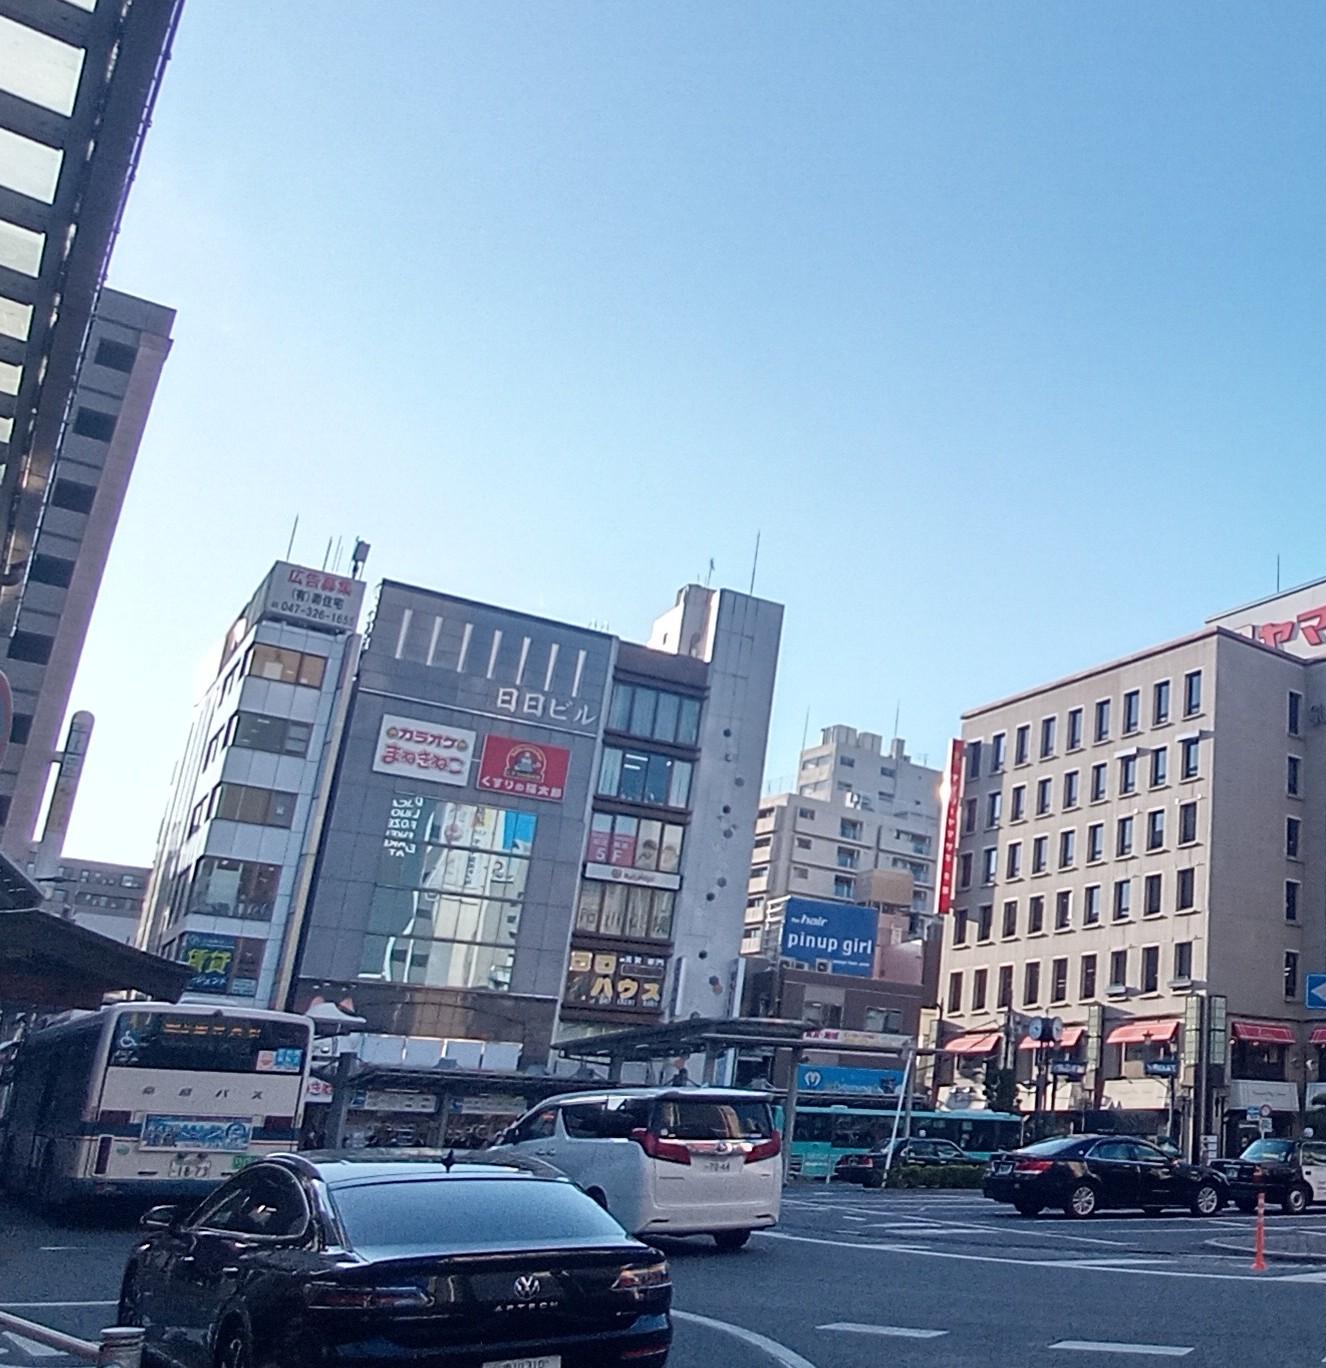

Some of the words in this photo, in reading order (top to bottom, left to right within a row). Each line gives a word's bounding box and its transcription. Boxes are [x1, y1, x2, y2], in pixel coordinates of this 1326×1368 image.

[497, 688, 597, 726] 日日ビル
[398, 728, 458, 750] カラオケ
[382, 745, 463, 774] まねきねこ
[481, 776, 564, 799] くすりの福太郎
[788, 932, 838, 952] pinup
[843, 938, 873, 955] girl
